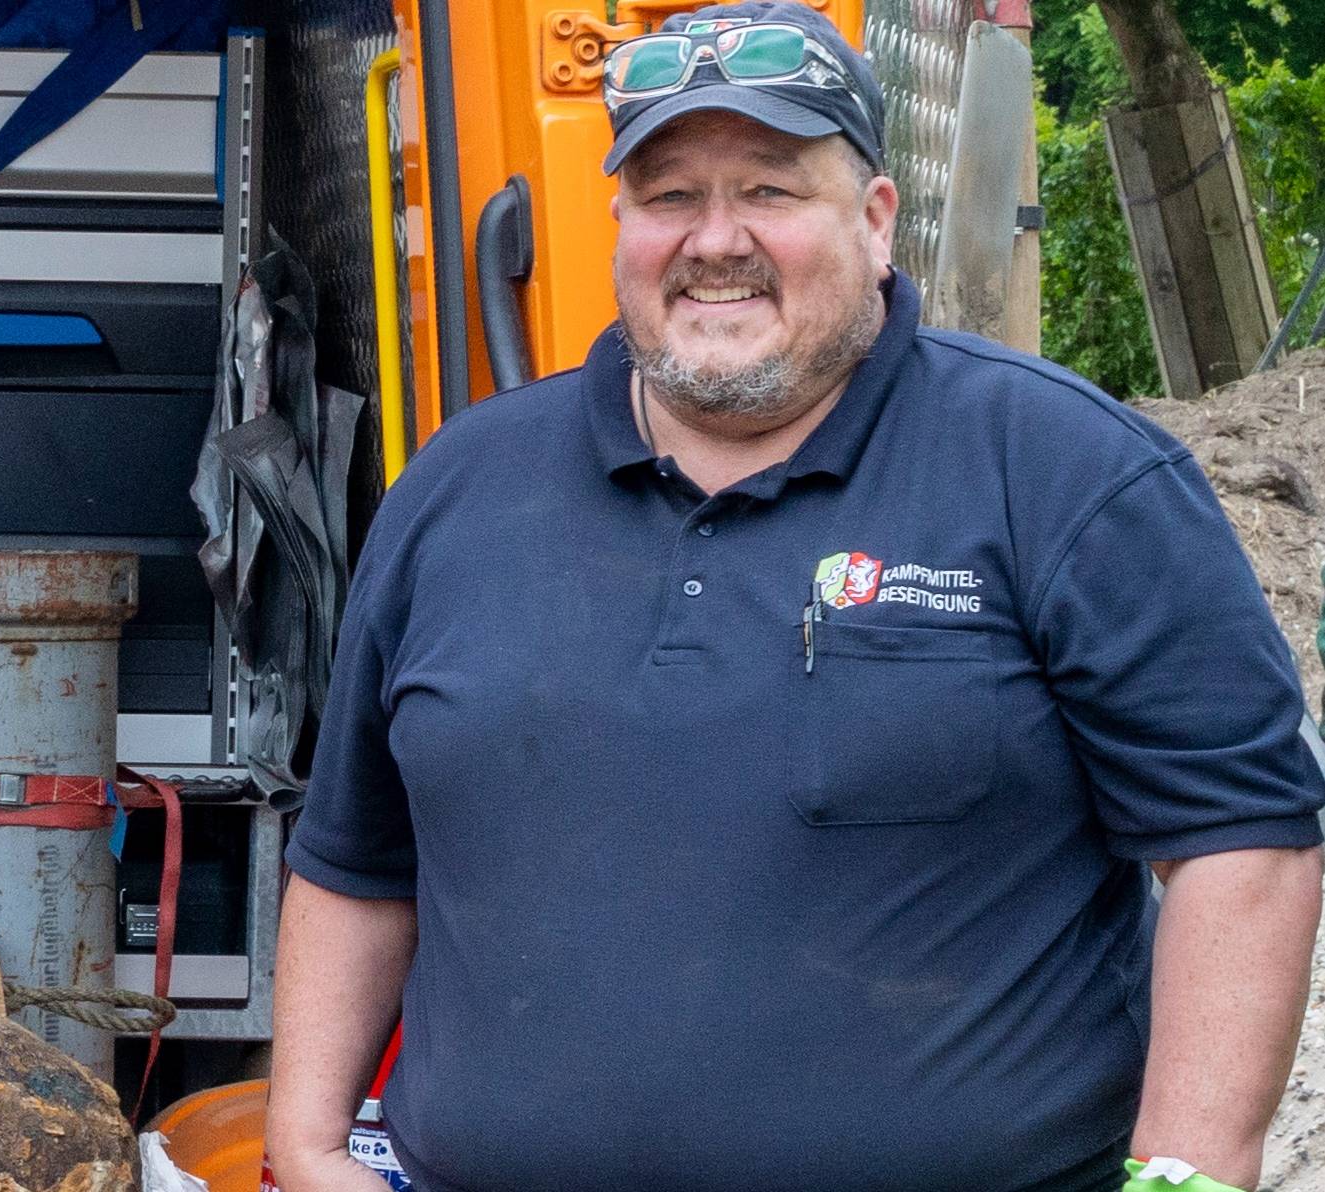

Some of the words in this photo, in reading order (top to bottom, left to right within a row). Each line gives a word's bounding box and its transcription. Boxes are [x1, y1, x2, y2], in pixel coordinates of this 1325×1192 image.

[882, 563, 984, 588] KAMPFMITTEL-
[877, 585, 982, 613] BESEITIGUNG
[352, 1139, 371, 1155] ke
